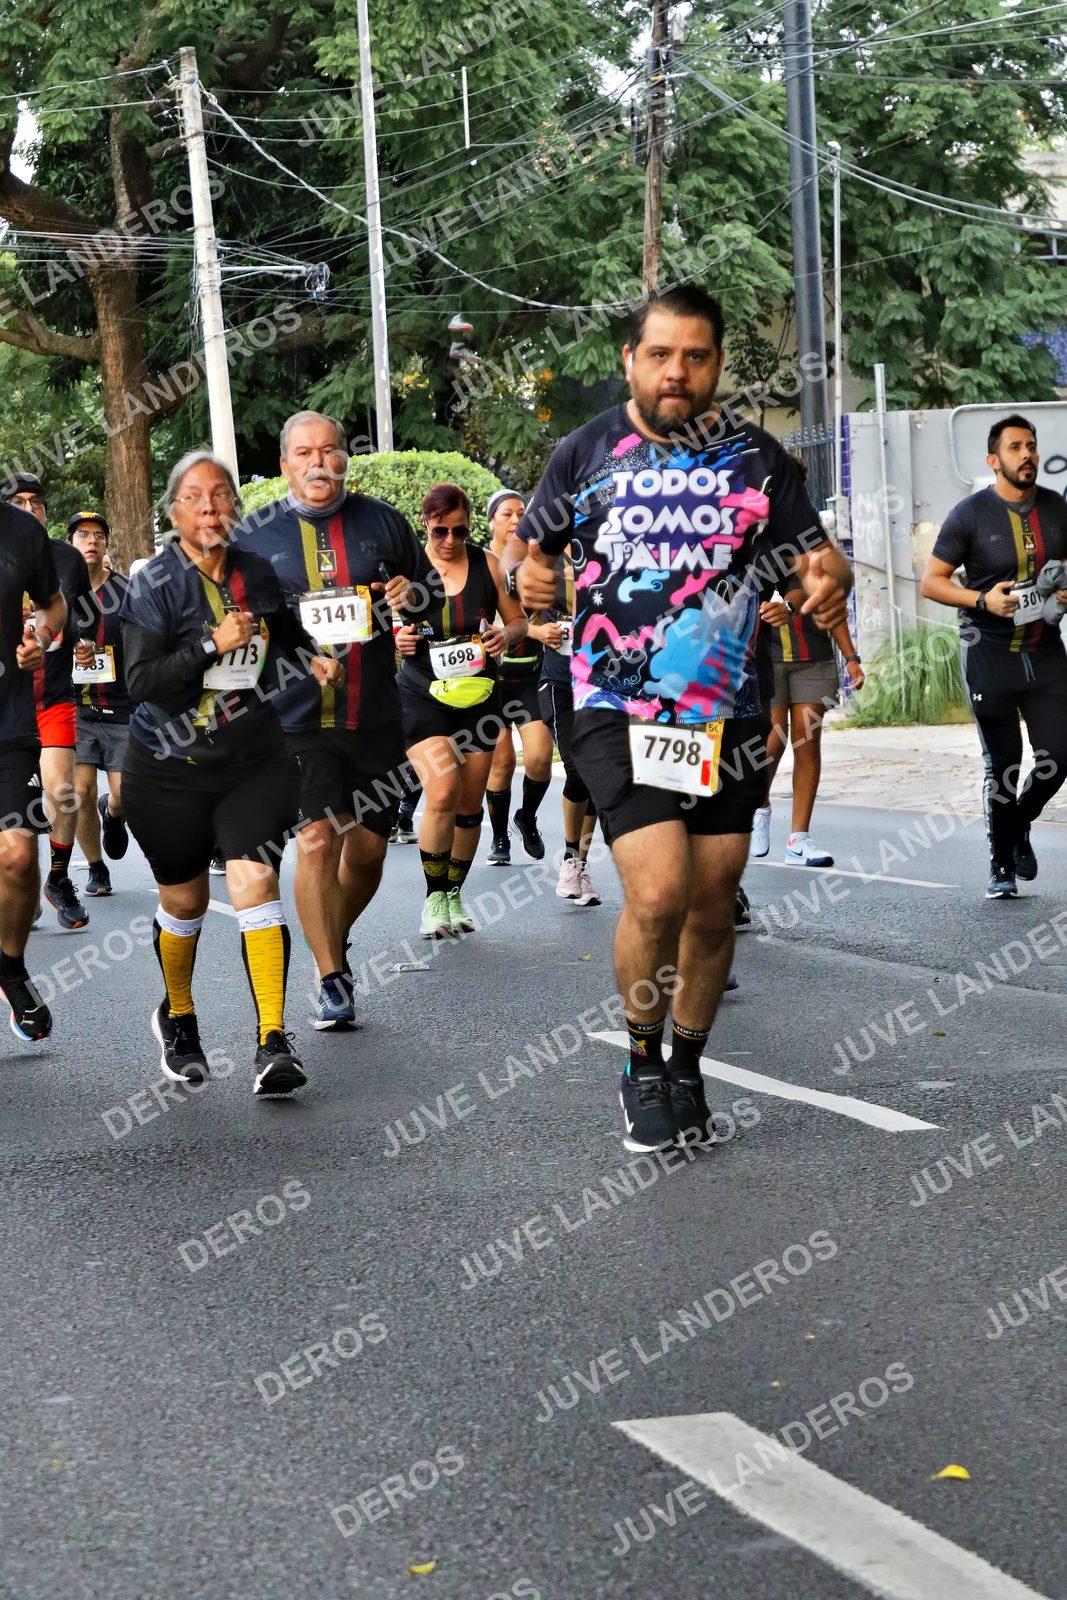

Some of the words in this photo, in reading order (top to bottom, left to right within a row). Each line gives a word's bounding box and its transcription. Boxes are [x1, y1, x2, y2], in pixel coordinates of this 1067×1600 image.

[612, 468, 733, 497] TODOS
[606, 504, 736, 535] SOMOS
[311, 603, 356, 625] 3141
[439, 647, 475, 667] 1698
[644, 735, 702, 766] 7798
